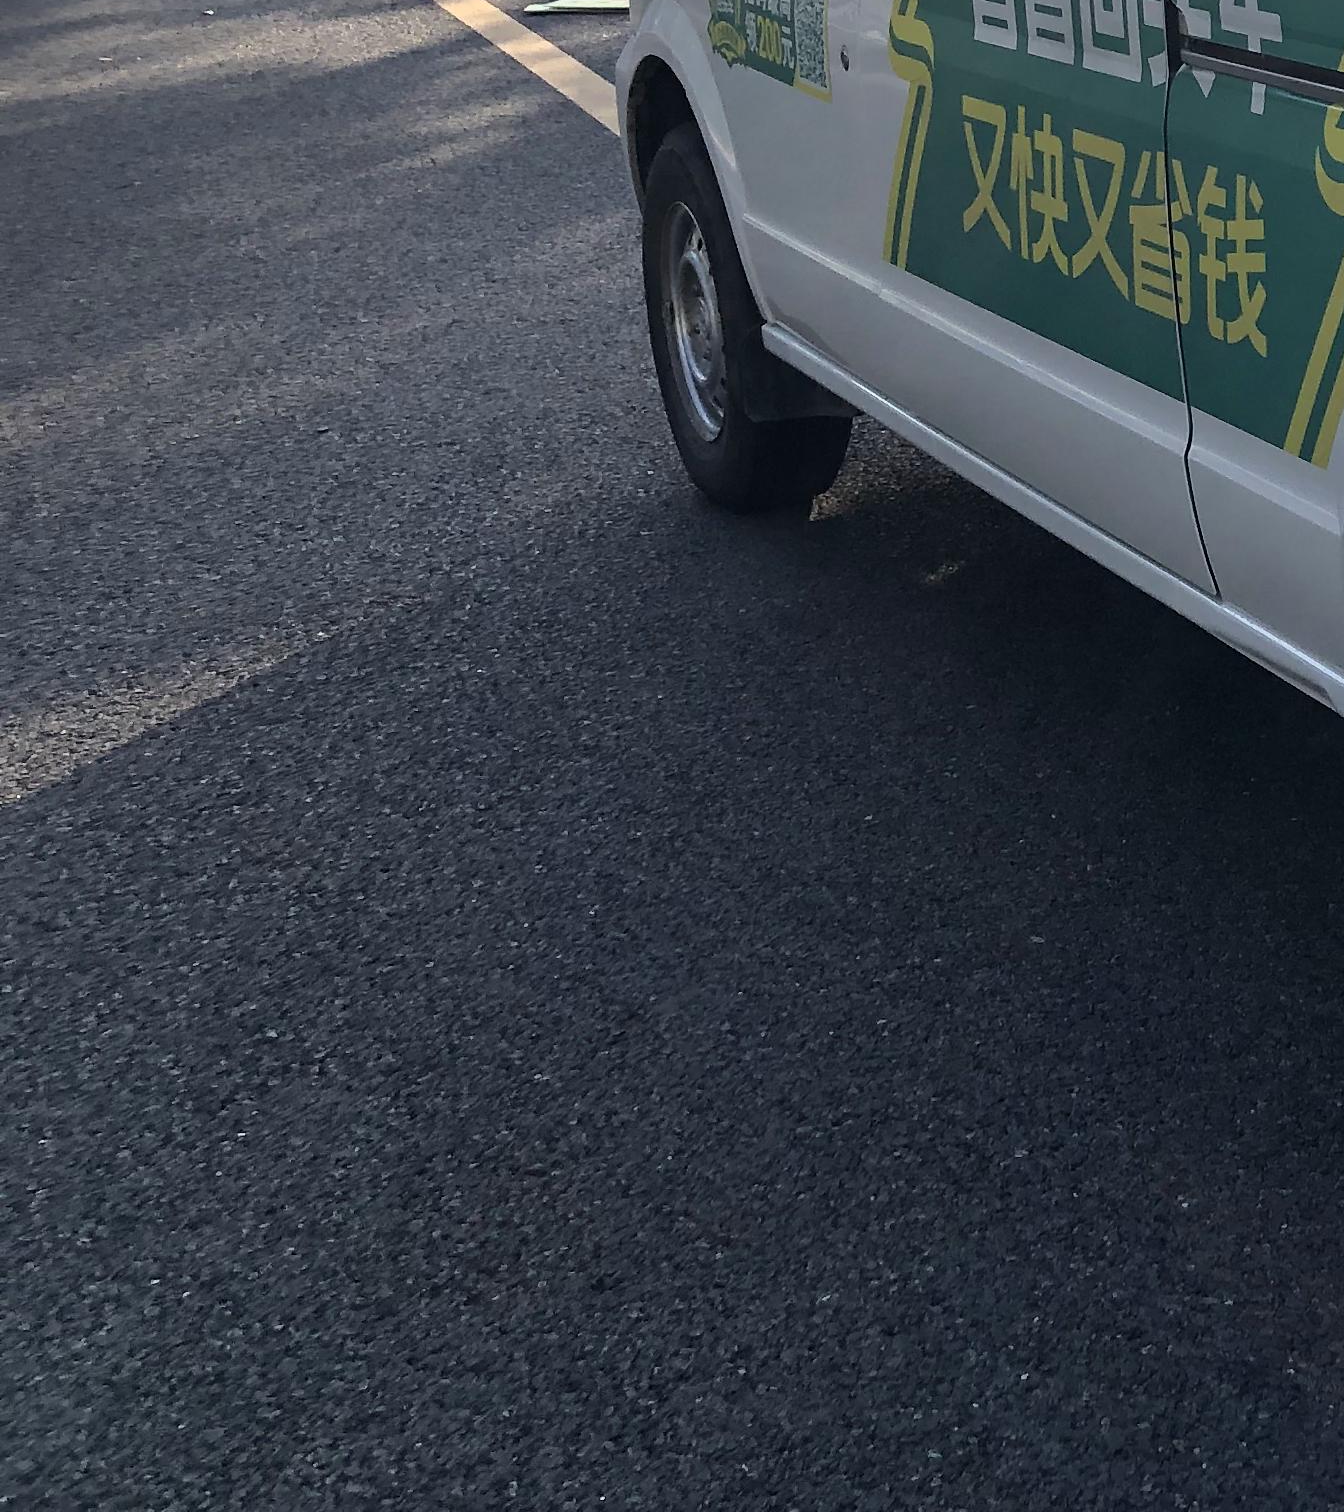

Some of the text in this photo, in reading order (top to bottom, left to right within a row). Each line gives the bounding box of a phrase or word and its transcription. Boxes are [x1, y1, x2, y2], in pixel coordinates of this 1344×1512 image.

[962, 95, 1267, 358] 又快又省钱
